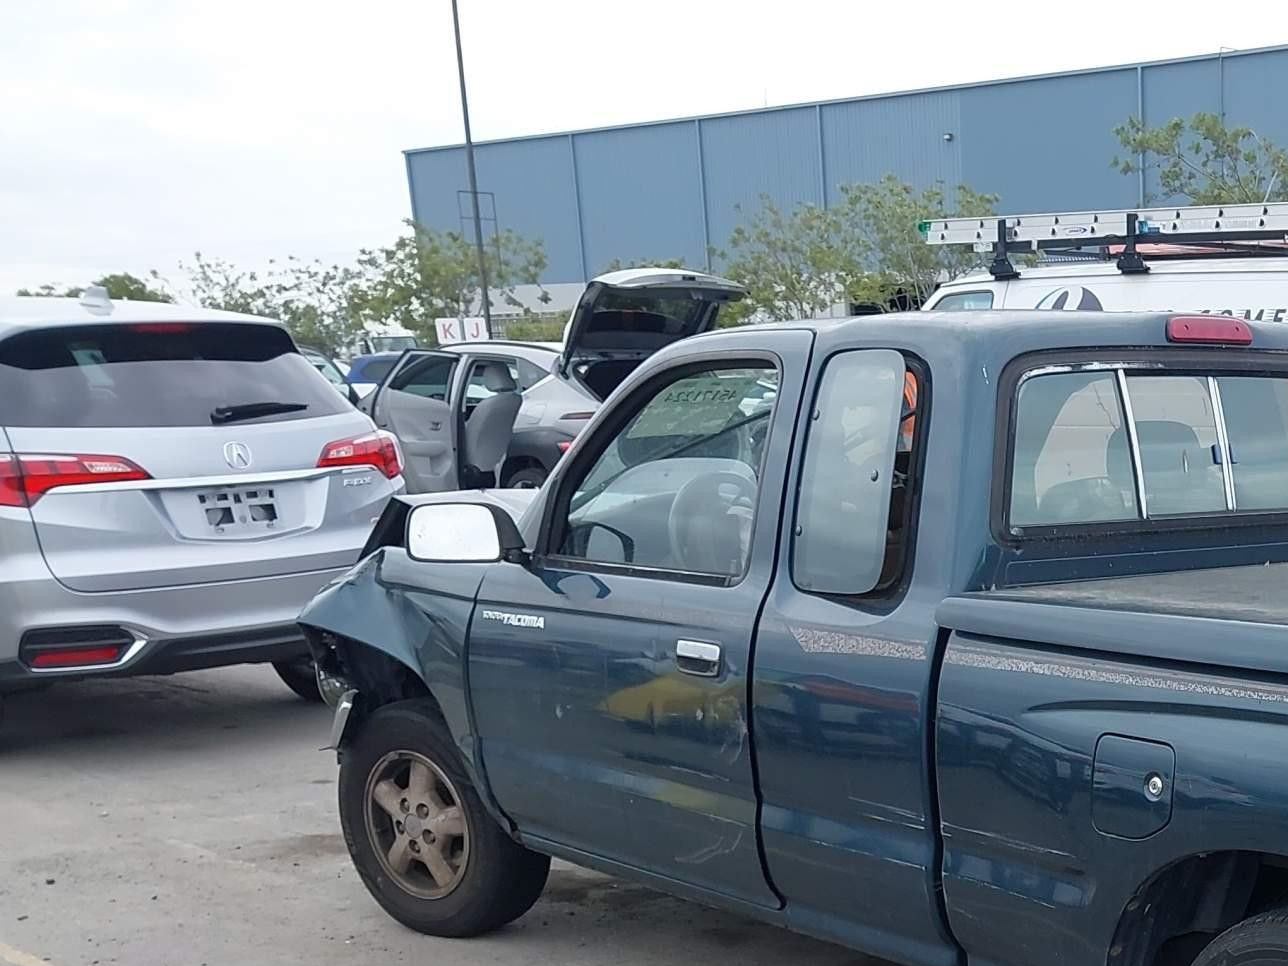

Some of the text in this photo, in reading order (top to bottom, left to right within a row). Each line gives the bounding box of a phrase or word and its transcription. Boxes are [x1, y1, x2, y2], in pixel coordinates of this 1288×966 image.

[442, 323, 455, 339] K
[471, 322, 480, 338] J
[502, 613, 545, 629] TACOMA
